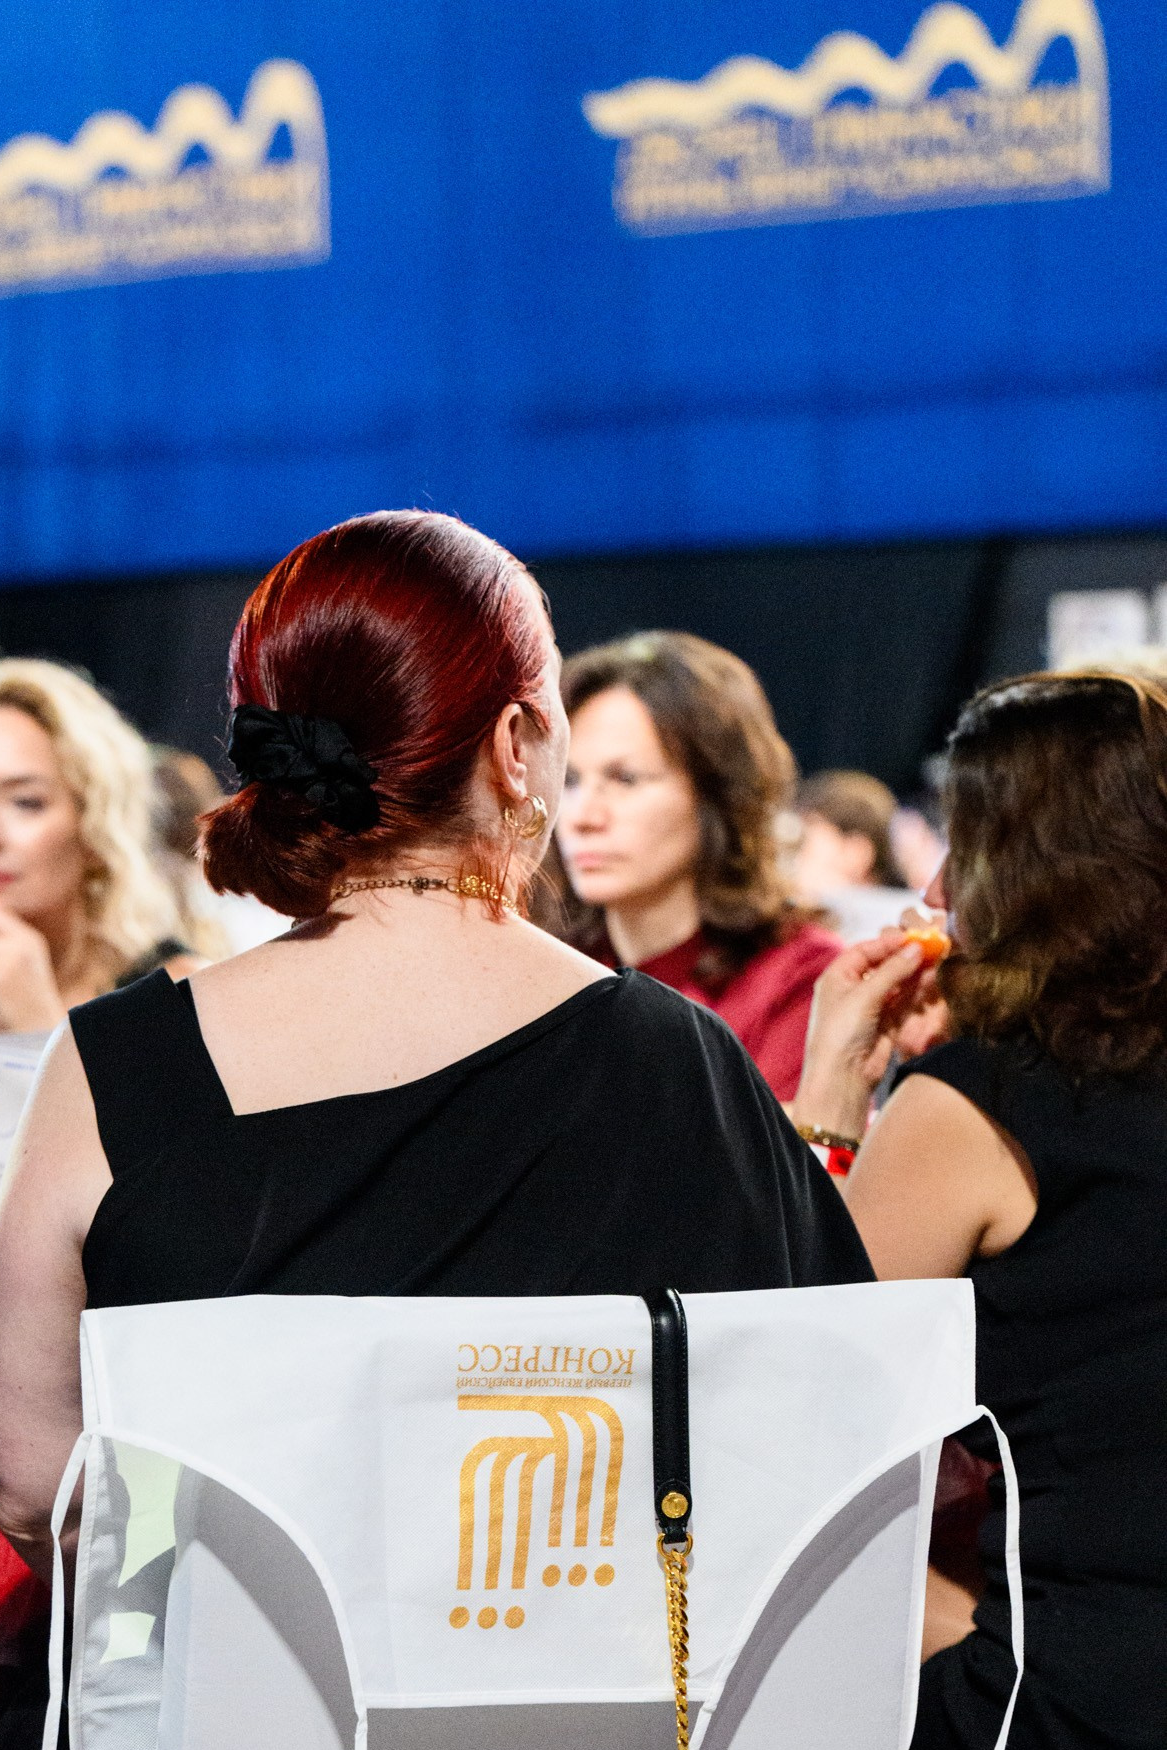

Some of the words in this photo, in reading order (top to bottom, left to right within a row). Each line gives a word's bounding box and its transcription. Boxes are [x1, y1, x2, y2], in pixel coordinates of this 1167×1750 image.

[457, 1344, 636, 1375] КОНГРЕСС
[456, 1376, 522, 1389] ЕВРЕЙСКИЙ
[524, 1377, 582, 1389] ЖЕНСКИЙ
[585, 1378, 632, 1389] ПЕРВЫЙ
